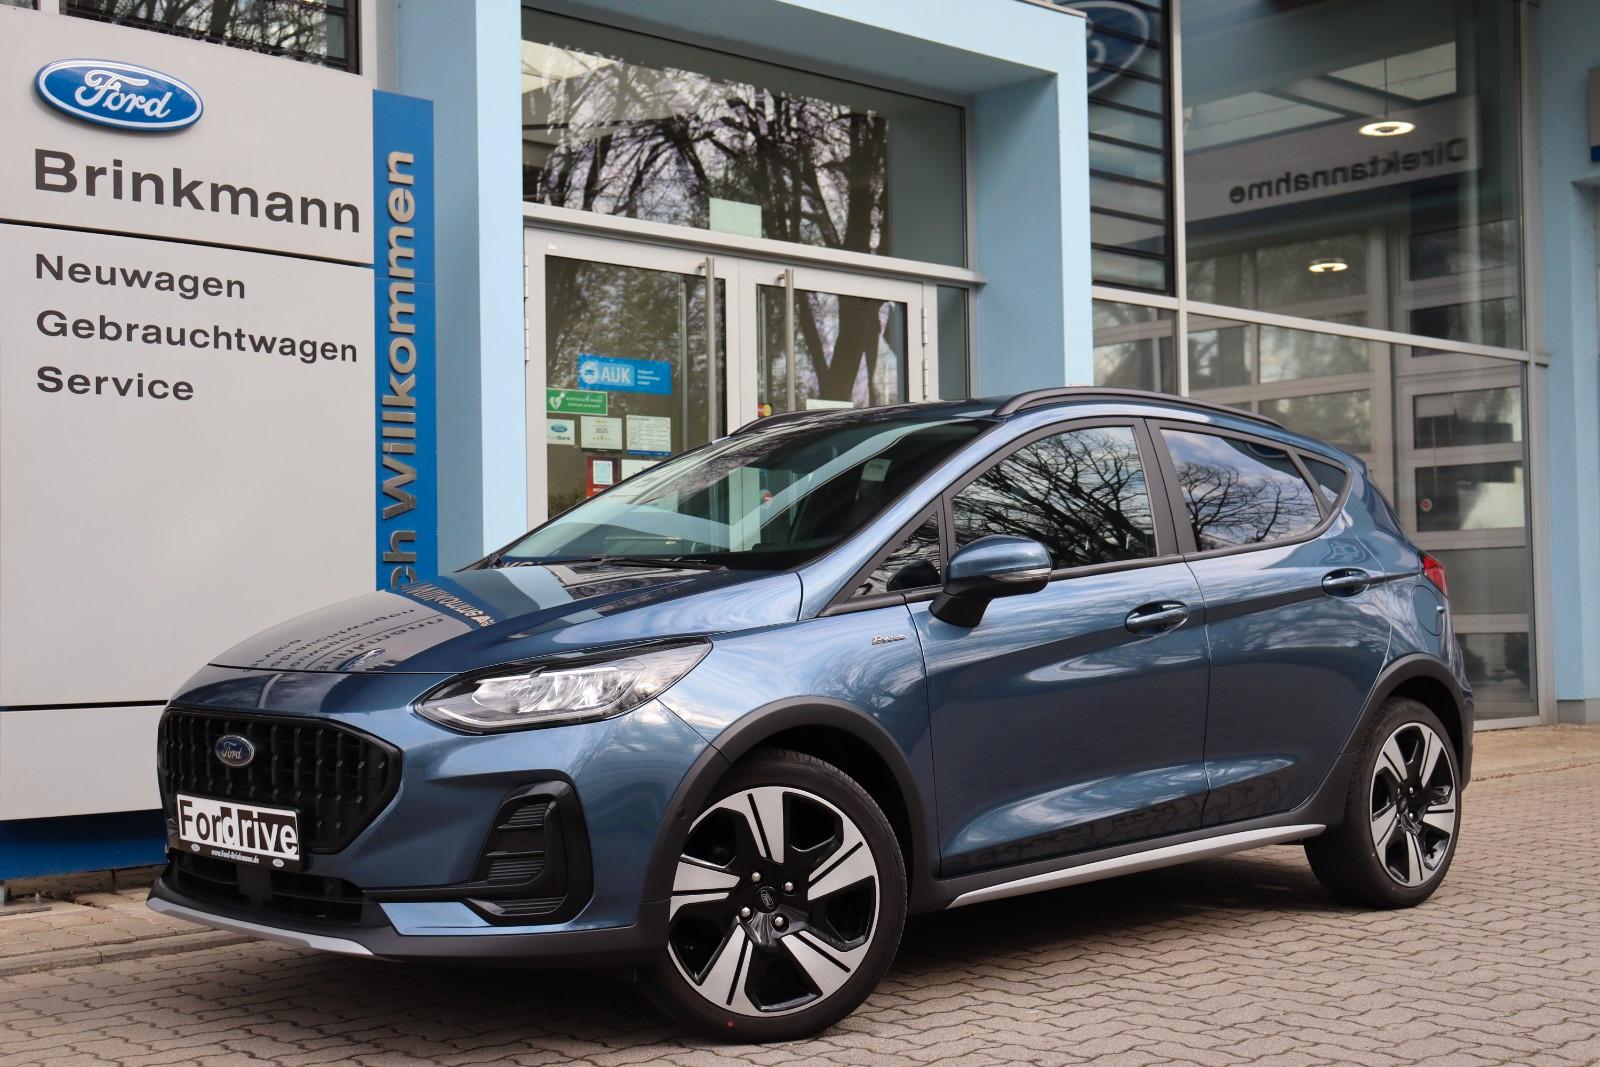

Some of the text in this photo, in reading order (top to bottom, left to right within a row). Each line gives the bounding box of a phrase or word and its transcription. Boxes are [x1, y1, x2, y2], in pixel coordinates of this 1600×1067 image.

[75, 69, 171, 119] Ford
[34, 148, 361, 234] Brinkmann
[36, 253, 246, 300] Neuwagen
[36, 310, 358, 364] Gebrauchtwagen
[382, 150, 416, 520] Willkommen
[37, 366, 194, 401] Service
[600, 366, 631, 384] AUK
[221, 741, 243, 760] Ford
[179, 800, 299, 855] Fordrive
